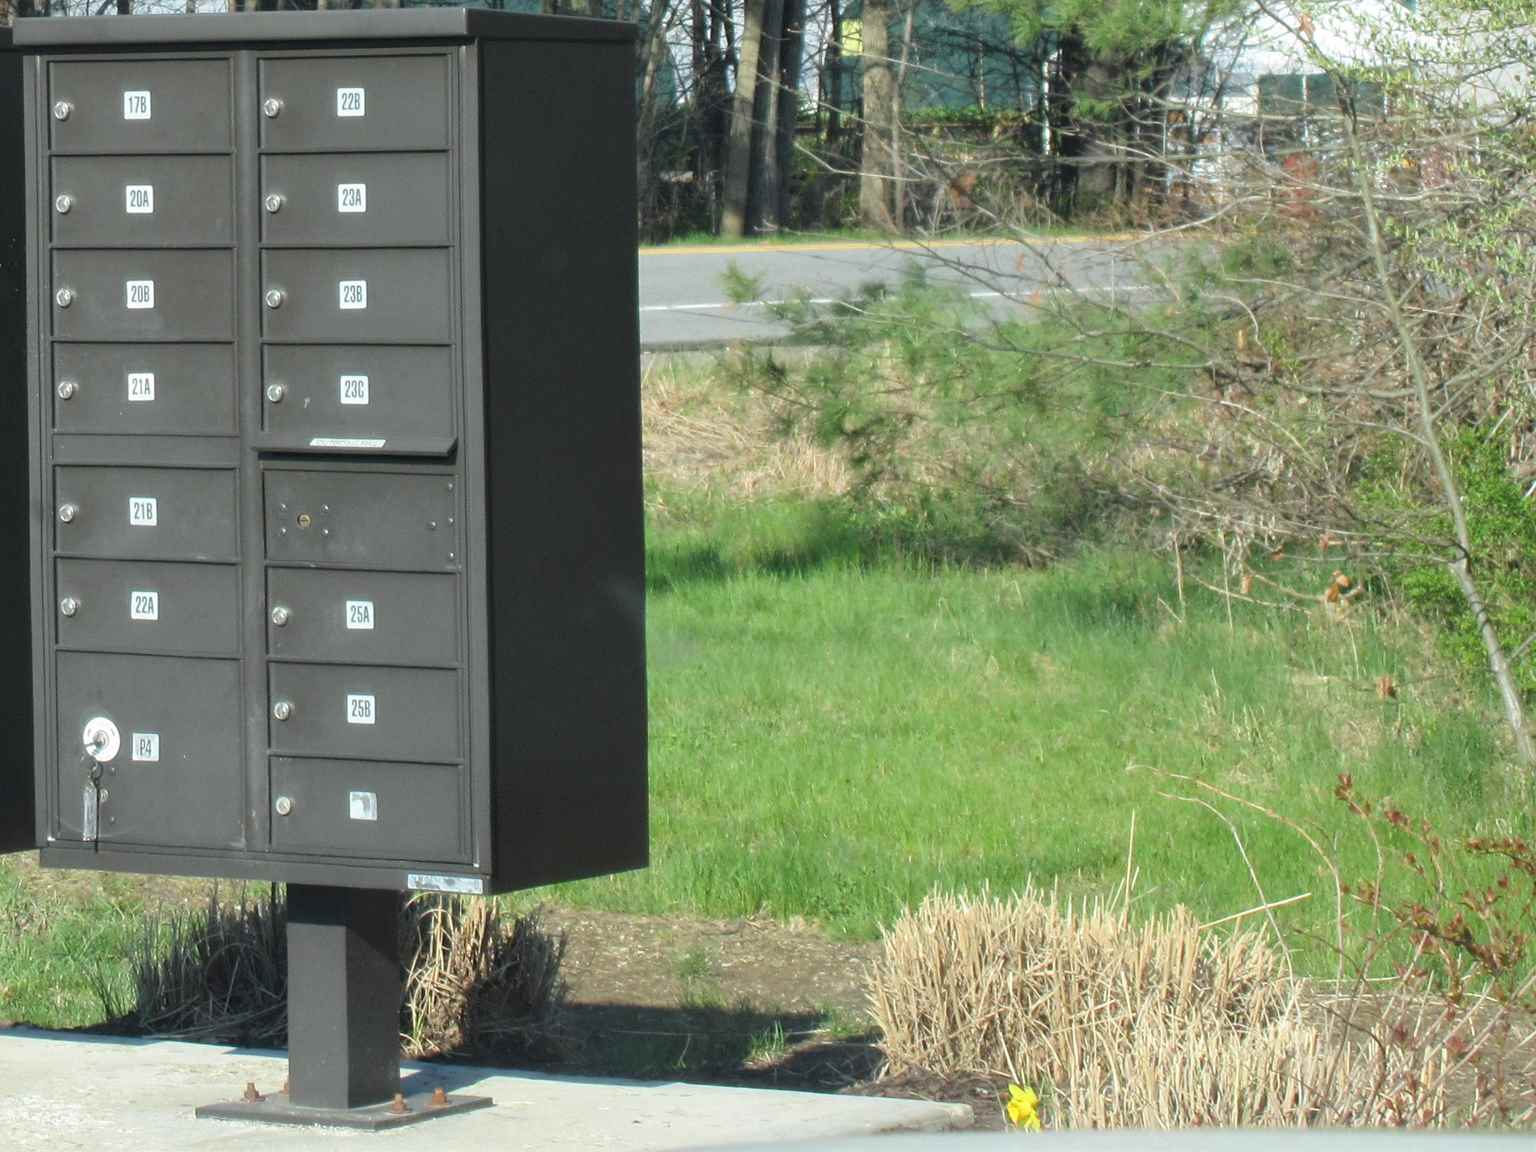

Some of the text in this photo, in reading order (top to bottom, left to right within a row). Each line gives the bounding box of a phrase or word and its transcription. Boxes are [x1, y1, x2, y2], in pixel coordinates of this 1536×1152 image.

[129, 96, 147, 113] 17B
[130, 190, 149, 207] 20A
[342, 188, 362, 206] 23A
[131, 285, 150, 303] 20B
[344, 285, 363, 303] 23B
[132, 378, 150, 395] 21A
[345, 380, 364, 398] 23C
[134, 502, 153, 520] 21B
[135, 596, 154, 614] 22A
[351, 605, 370, 623] 25A
[351, 699, 371, 718] 25B
